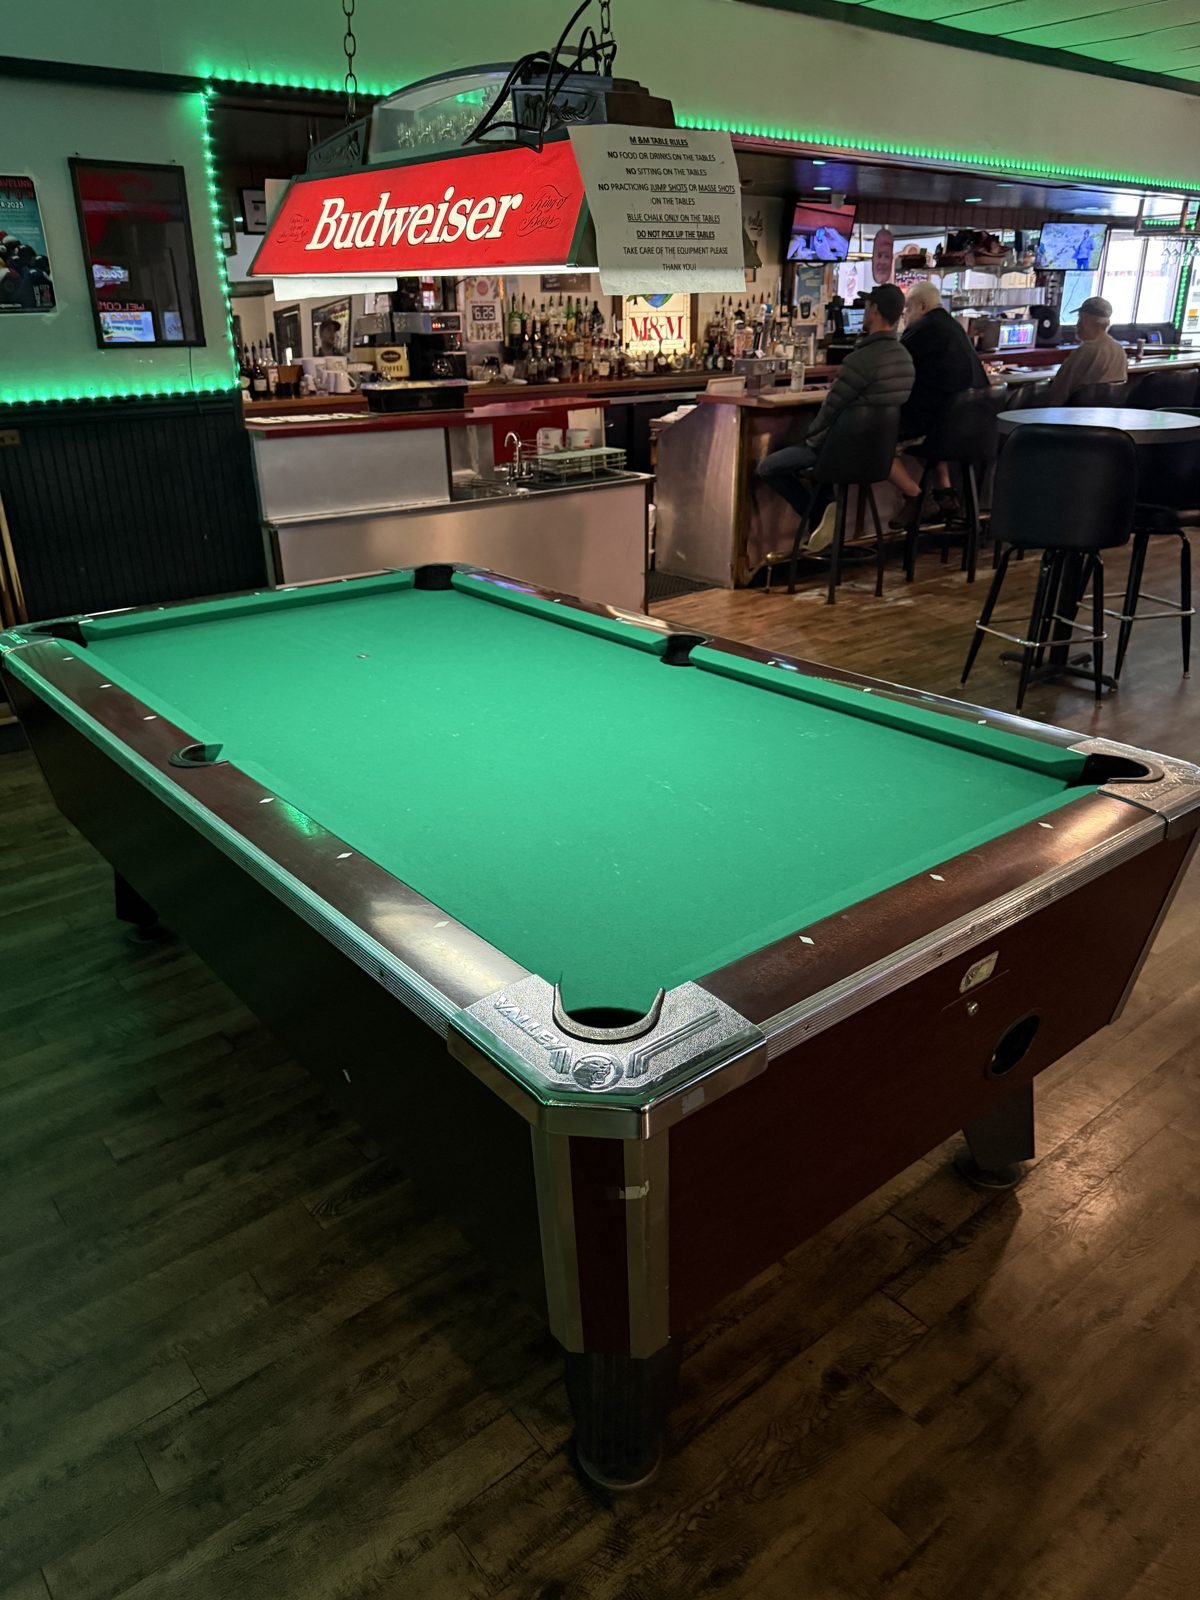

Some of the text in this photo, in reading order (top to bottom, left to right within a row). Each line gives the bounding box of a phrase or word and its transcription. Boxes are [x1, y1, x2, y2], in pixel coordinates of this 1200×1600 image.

[650, 137, 668, 145] TABLE
[669, 138, 688, 146] RULES
[607, 151, 716, 162] NO FOOD OR DRINKS ON THE TABLES
[625, 167, 707, 177] NO SITTING ON THE TABLES
[598, 183, 736, 193] NO PRACTICING JUMP SHOTS OR MASSE SHOTS
[651, 197, 696, 206] ON THE TABLES
[304, 185, 524, 252] Budweiser
[626, 213, 720, 223] BLUE CHALK ONLY ON THE TABLES
[636, 230, 715, 239] DO NOT PICK UP THE TABLES
[623, 246, 729, 256] TAKE CARE OF THE EQUIPMENT PLEASE
[662, 263, 697, 271] THANK YOU!
[629, 315, 684, 341] M&M
[494, 996, 573, 1062] VALLEY
